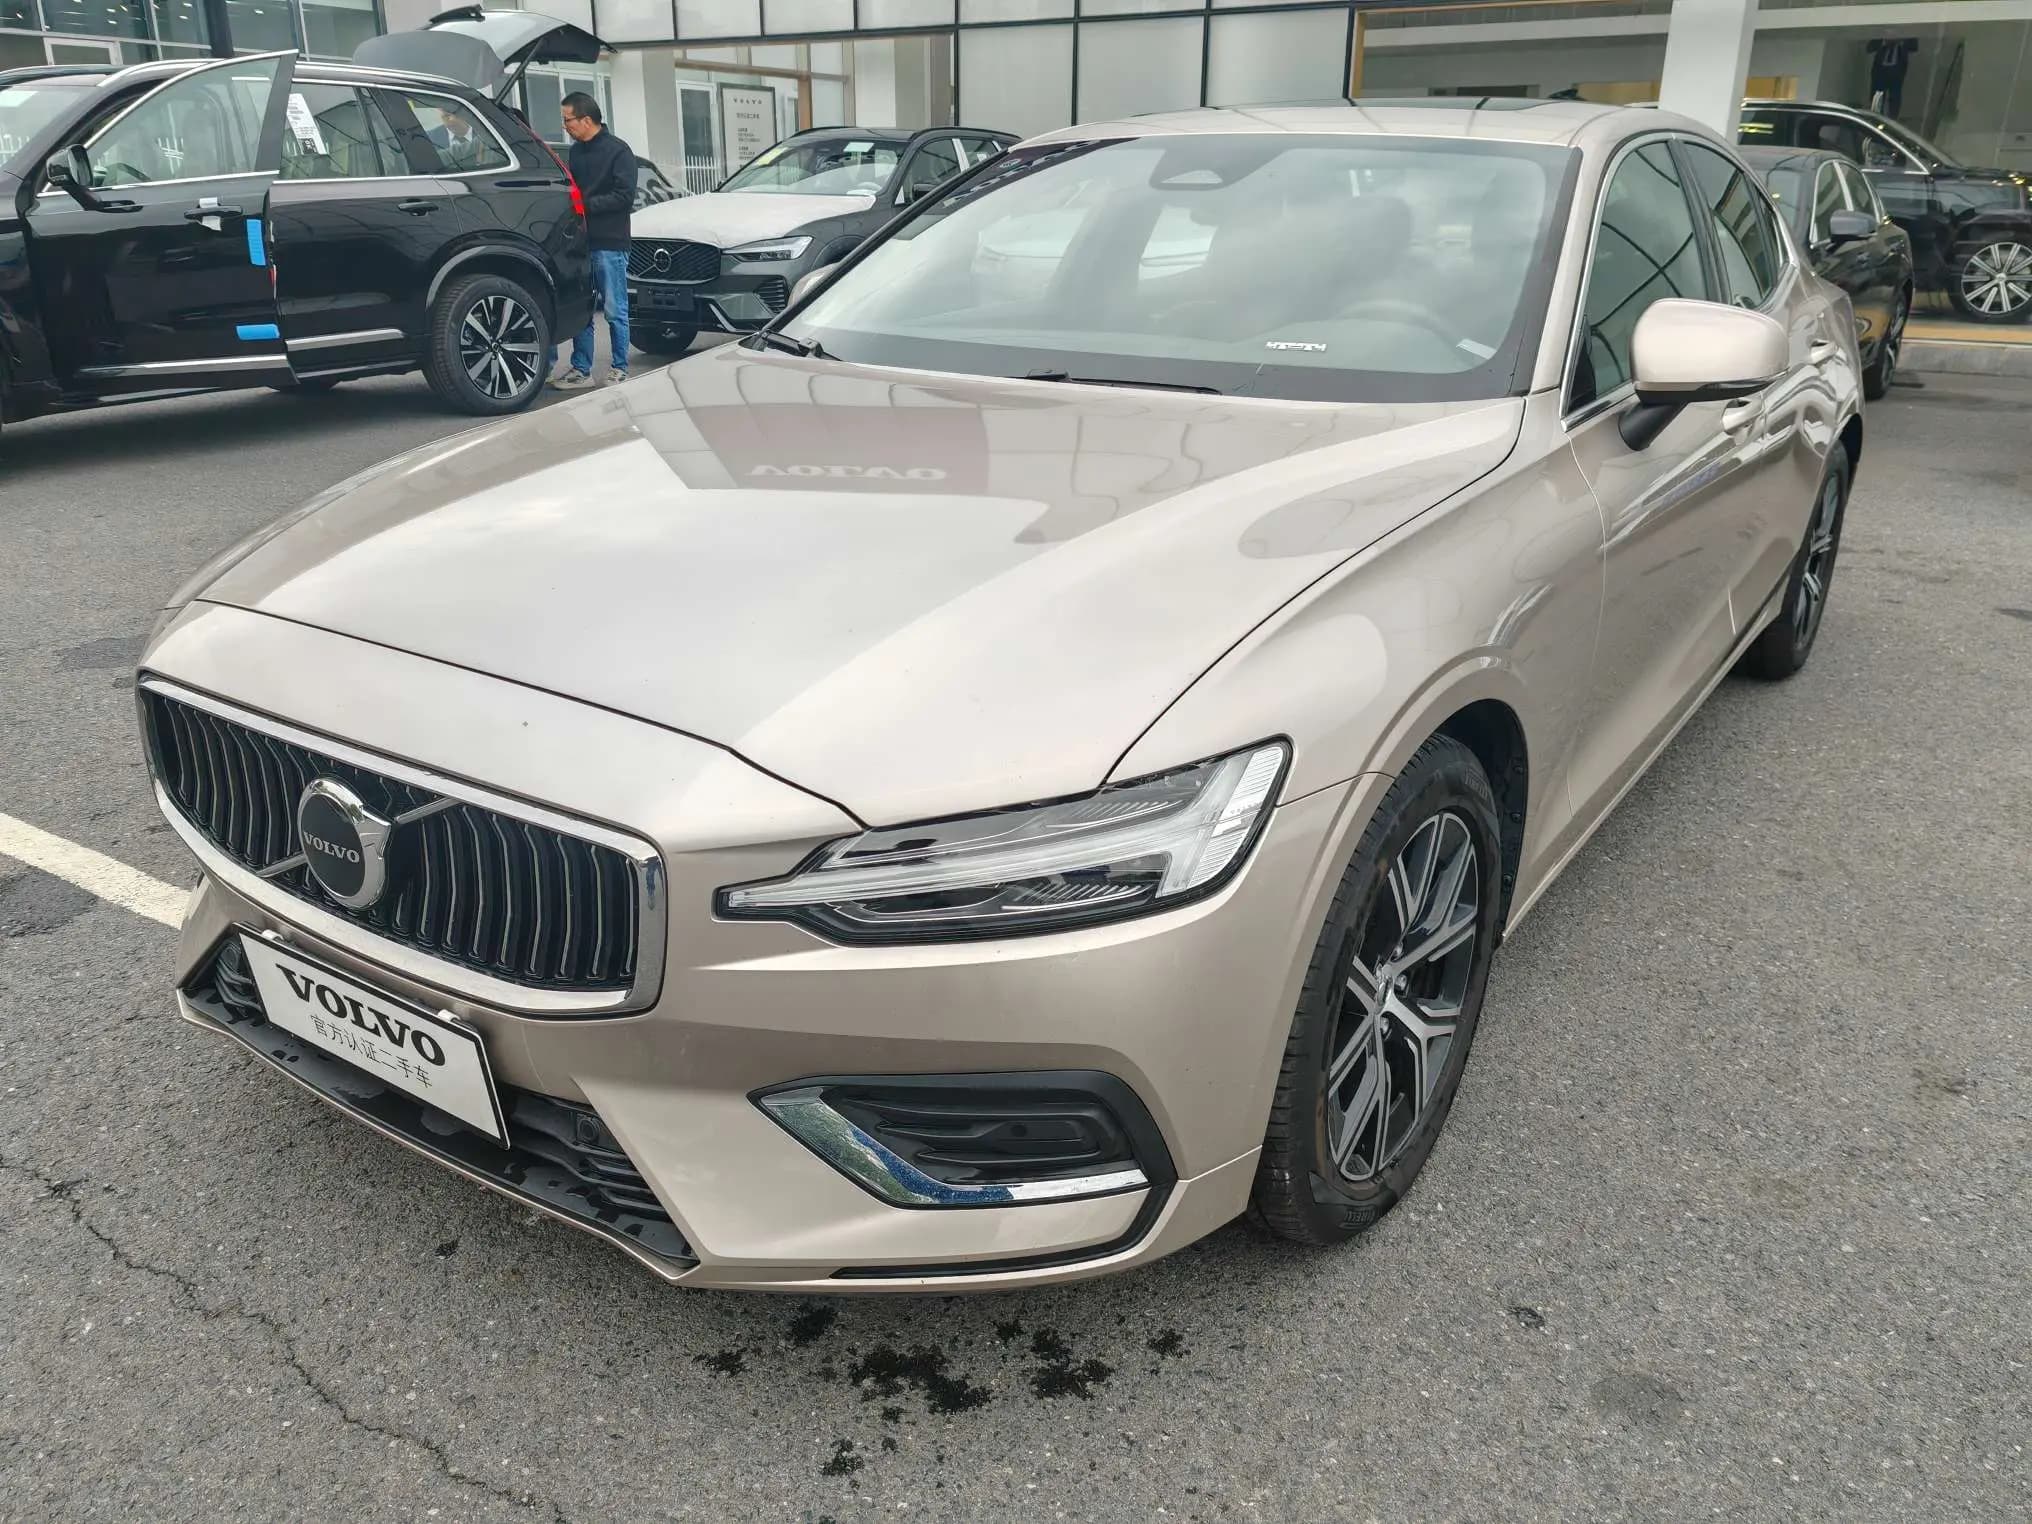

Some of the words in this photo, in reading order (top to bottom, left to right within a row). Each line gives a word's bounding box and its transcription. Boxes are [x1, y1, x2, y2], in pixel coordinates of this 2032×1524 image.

[303, 831, 360, 863] VOLVO
[275, 962, 446, 1067] VOLVO
[310, 1014, 433, 1089] 官方认证二手车
